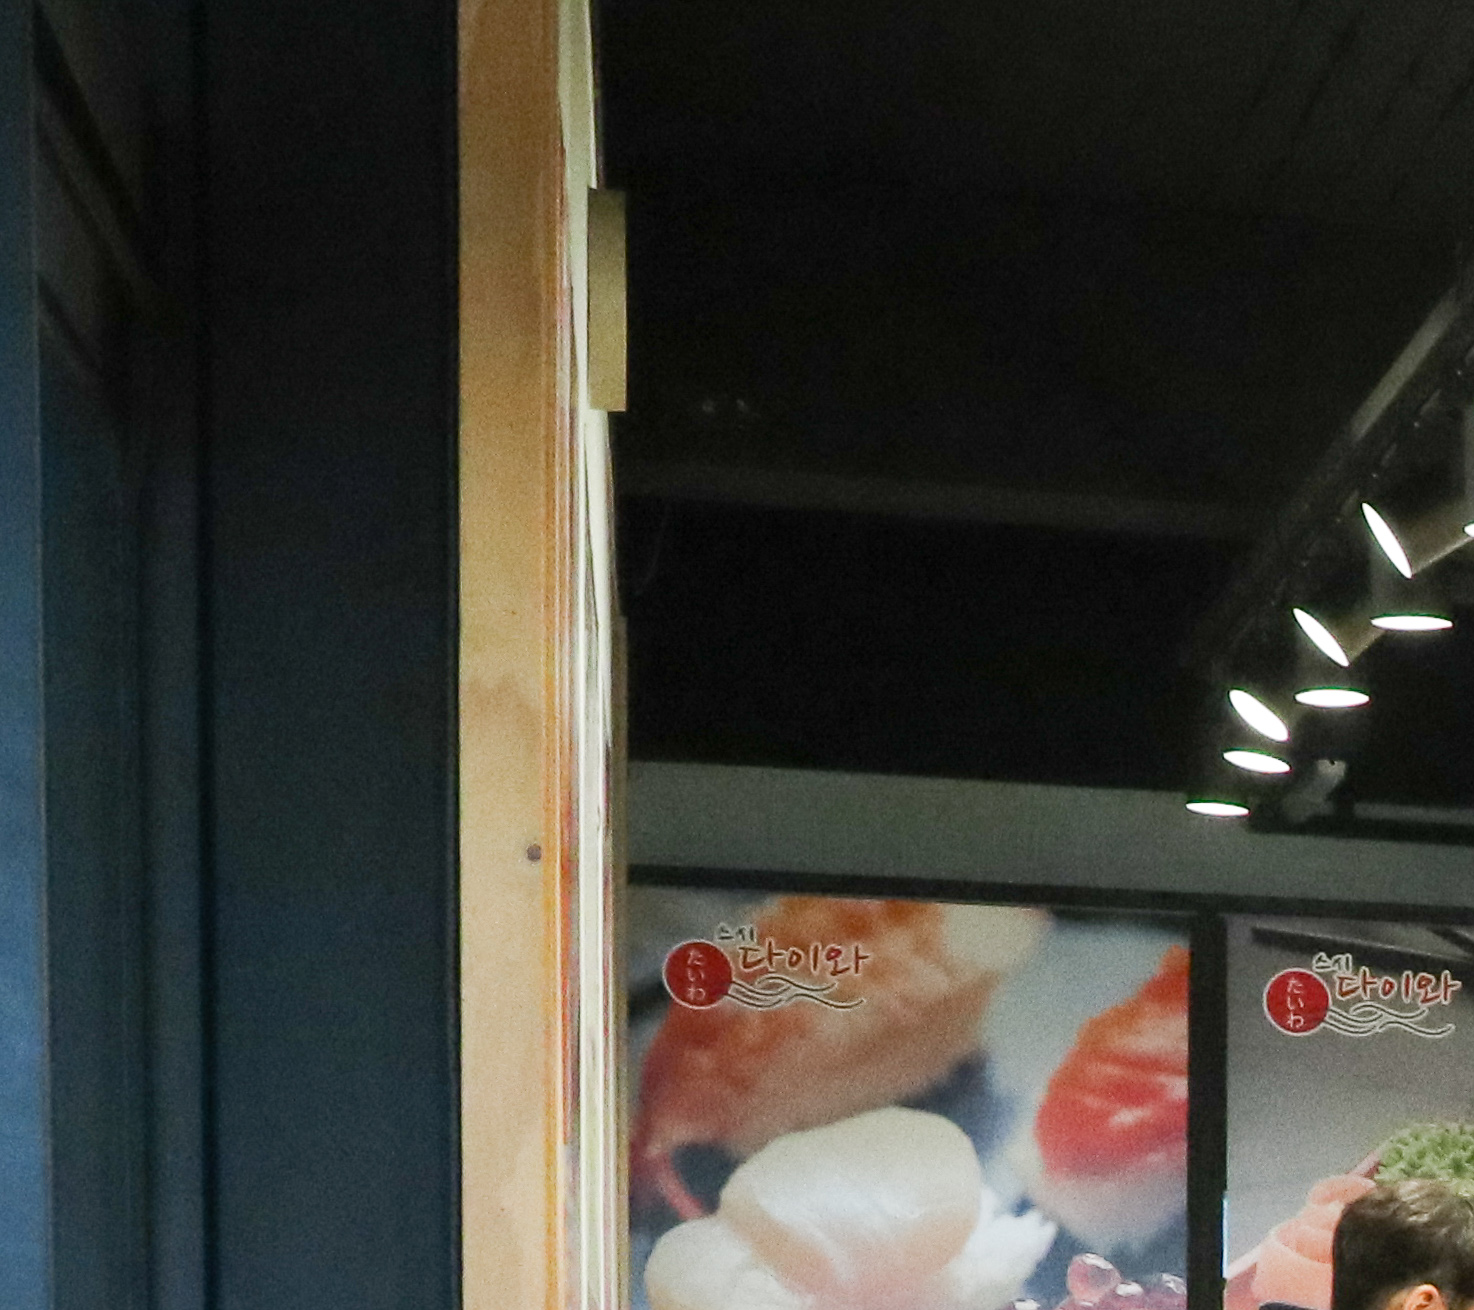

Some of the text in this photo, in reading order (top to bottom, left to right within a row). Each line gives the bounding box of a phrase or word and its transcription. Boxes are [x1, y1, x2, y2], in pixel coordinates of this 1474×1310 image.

[737, 938, 870, 977] 다이와
[1312, 952, 1353, 972] 스시
[1286, 977, 1305, 1028] たいわ
[1335, 966, 1463, 1006] 다이와
